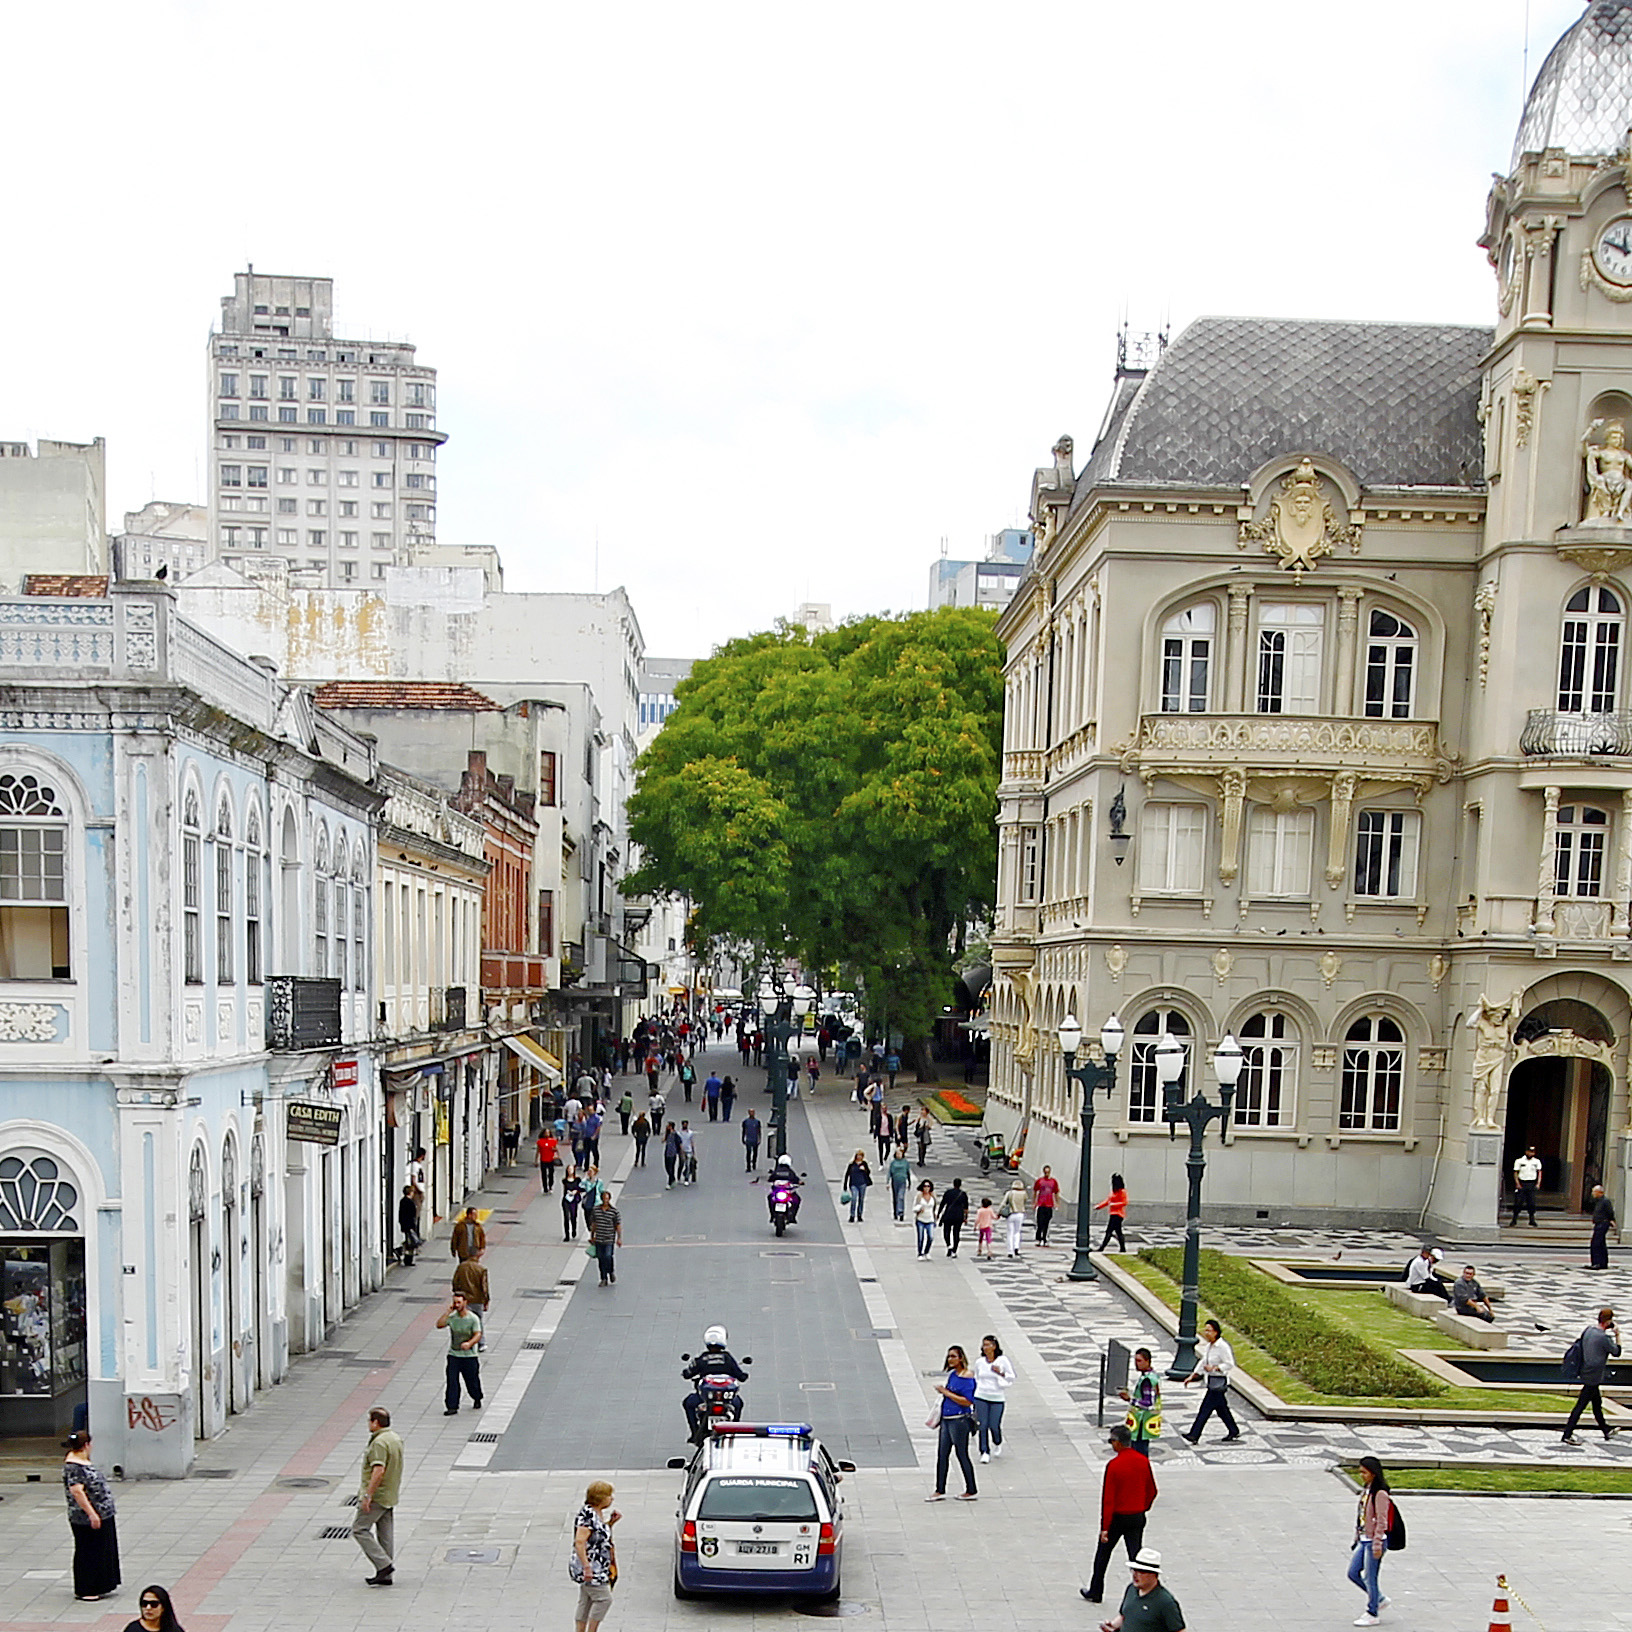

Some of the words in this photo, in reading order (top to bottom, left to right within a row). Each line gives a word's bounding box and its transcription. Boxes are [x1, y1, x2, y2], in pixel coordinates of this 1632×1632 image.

[290, 1105, 312, 1119] CASA
[313, 1109, 340, 1123] EDITH
[723, 1391, 734, 1400] 02
[719, 1479, 754, 1487] GUARDA
[755, 1479, 799, 1489] MUNICIPAL
[793, 1553, 810, 1564] R1
